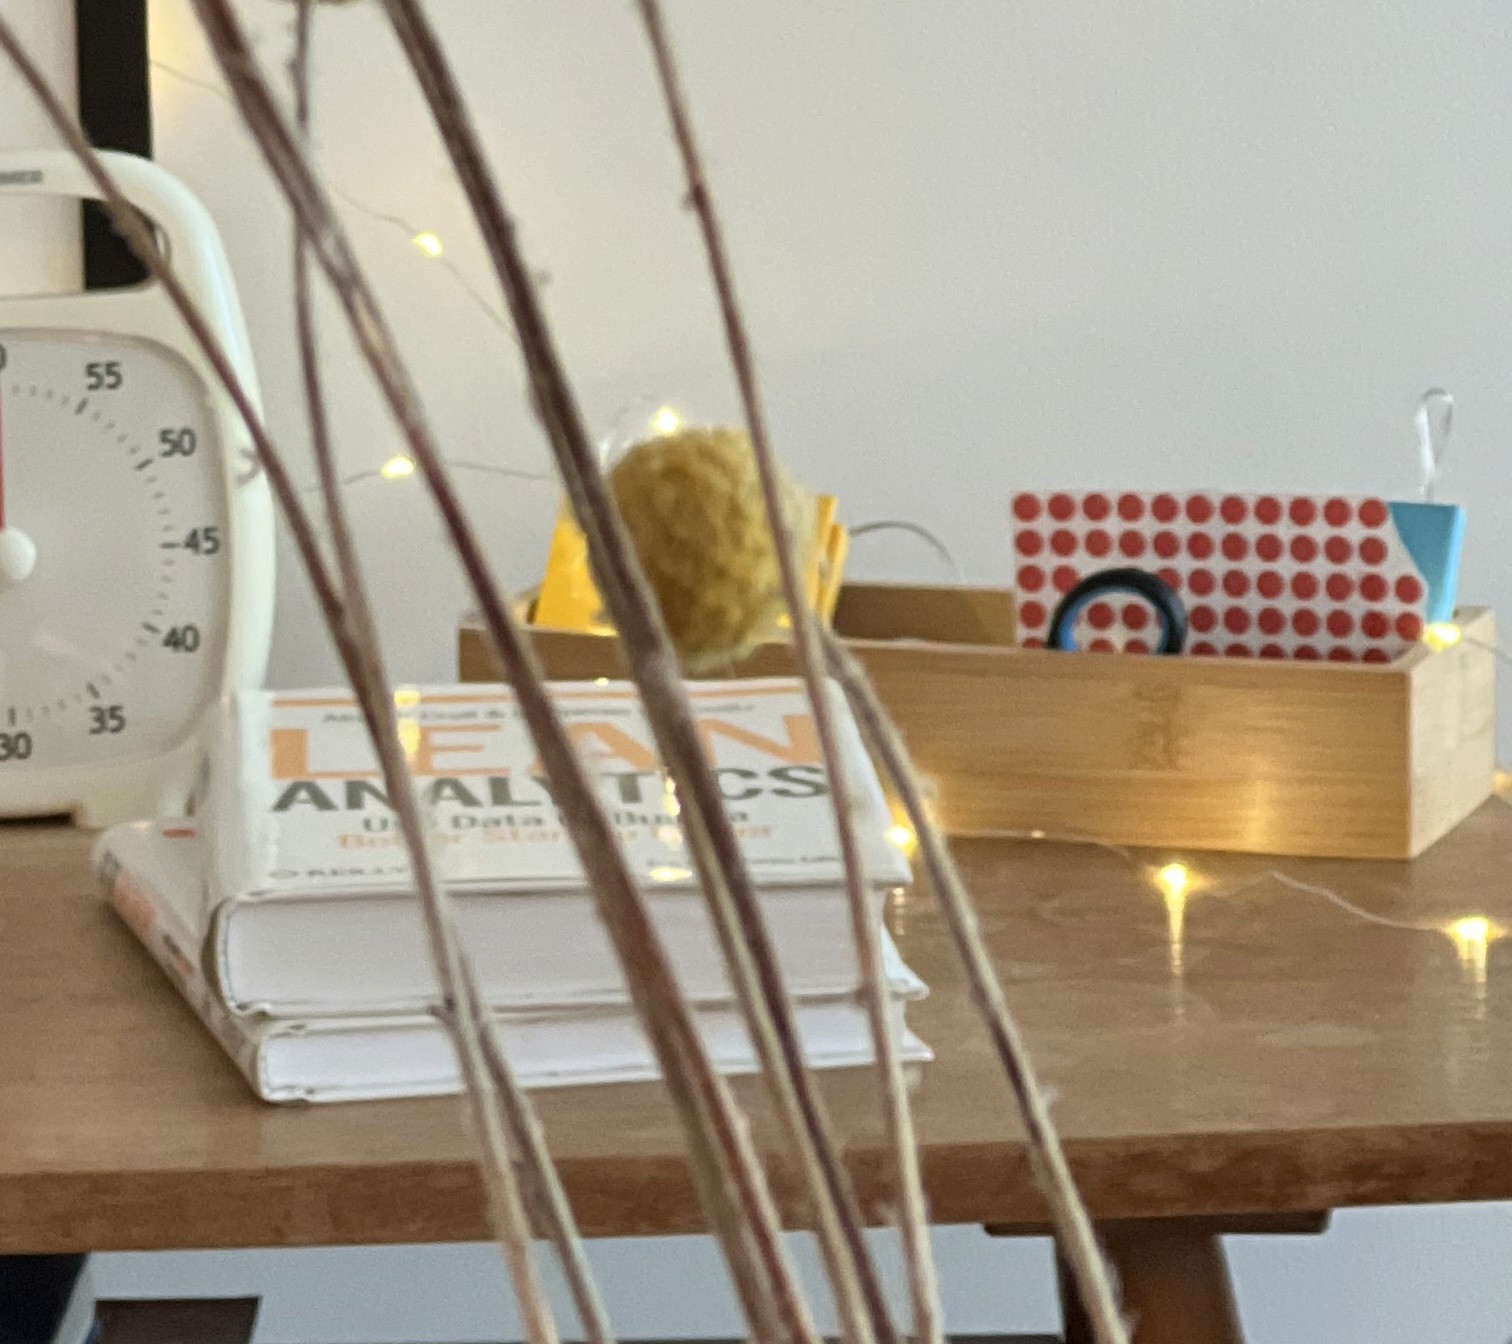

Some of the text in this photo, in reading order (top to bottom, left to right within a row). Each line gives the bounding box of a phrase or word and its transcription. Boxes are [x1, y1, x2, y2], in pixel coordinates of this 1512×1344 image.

[85, 362, 123, 390] 55
[159, 428, 196, 458] 50
[183, 526, 220, 555] 45
[163, 624, 200, 654] 40
[89, 706, 126, 735] 35
[274, 765, 831, 812] ANALTCS
